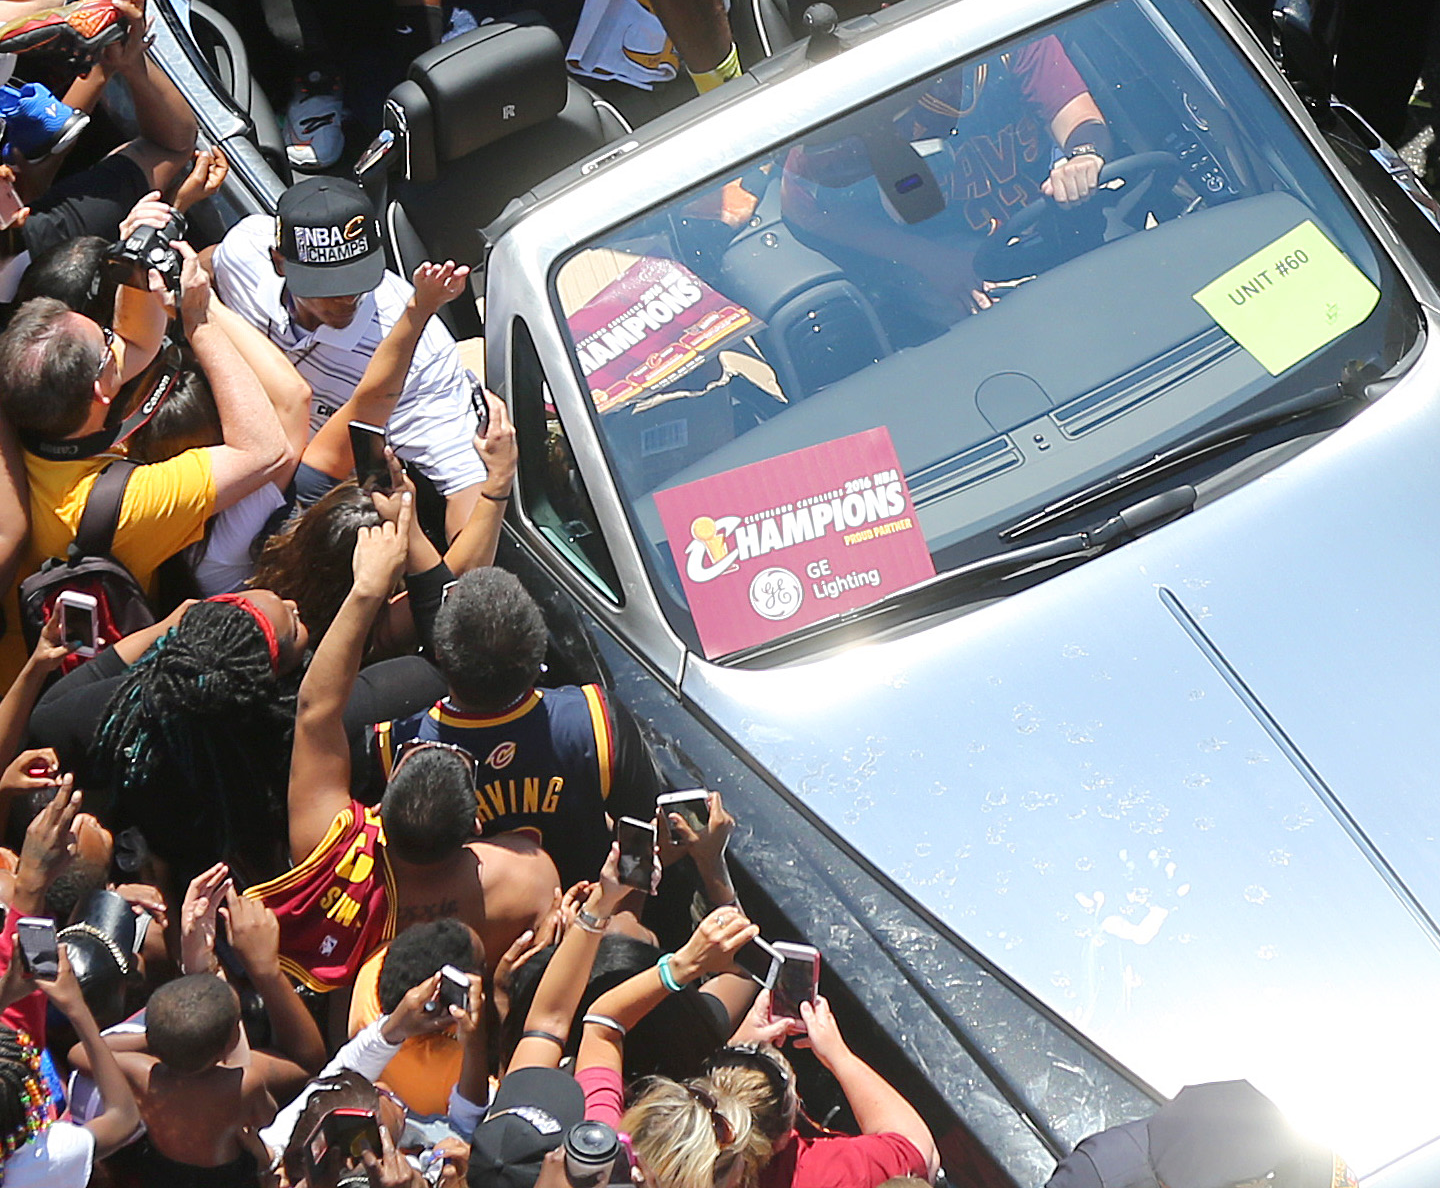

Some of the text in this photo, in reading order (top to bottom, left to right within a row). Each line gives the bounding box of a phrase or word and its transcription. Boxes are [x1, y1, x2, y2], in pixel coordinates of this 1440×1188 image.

[305, 224, 344, 248] NBA
[308, 236, 369, 263] CHAMPS
[1227, 248, 1309, 307] UNIT #60
[142, 374, 170, 415] Canon
[844, 478, 872, 495] 2016
[873, 469, 898, 485] NBA
[843, 517, 913, 548] PROUD PARTNER
[802, 559, 828, 580] GE
[809, 569, 882, 600] Lighting
